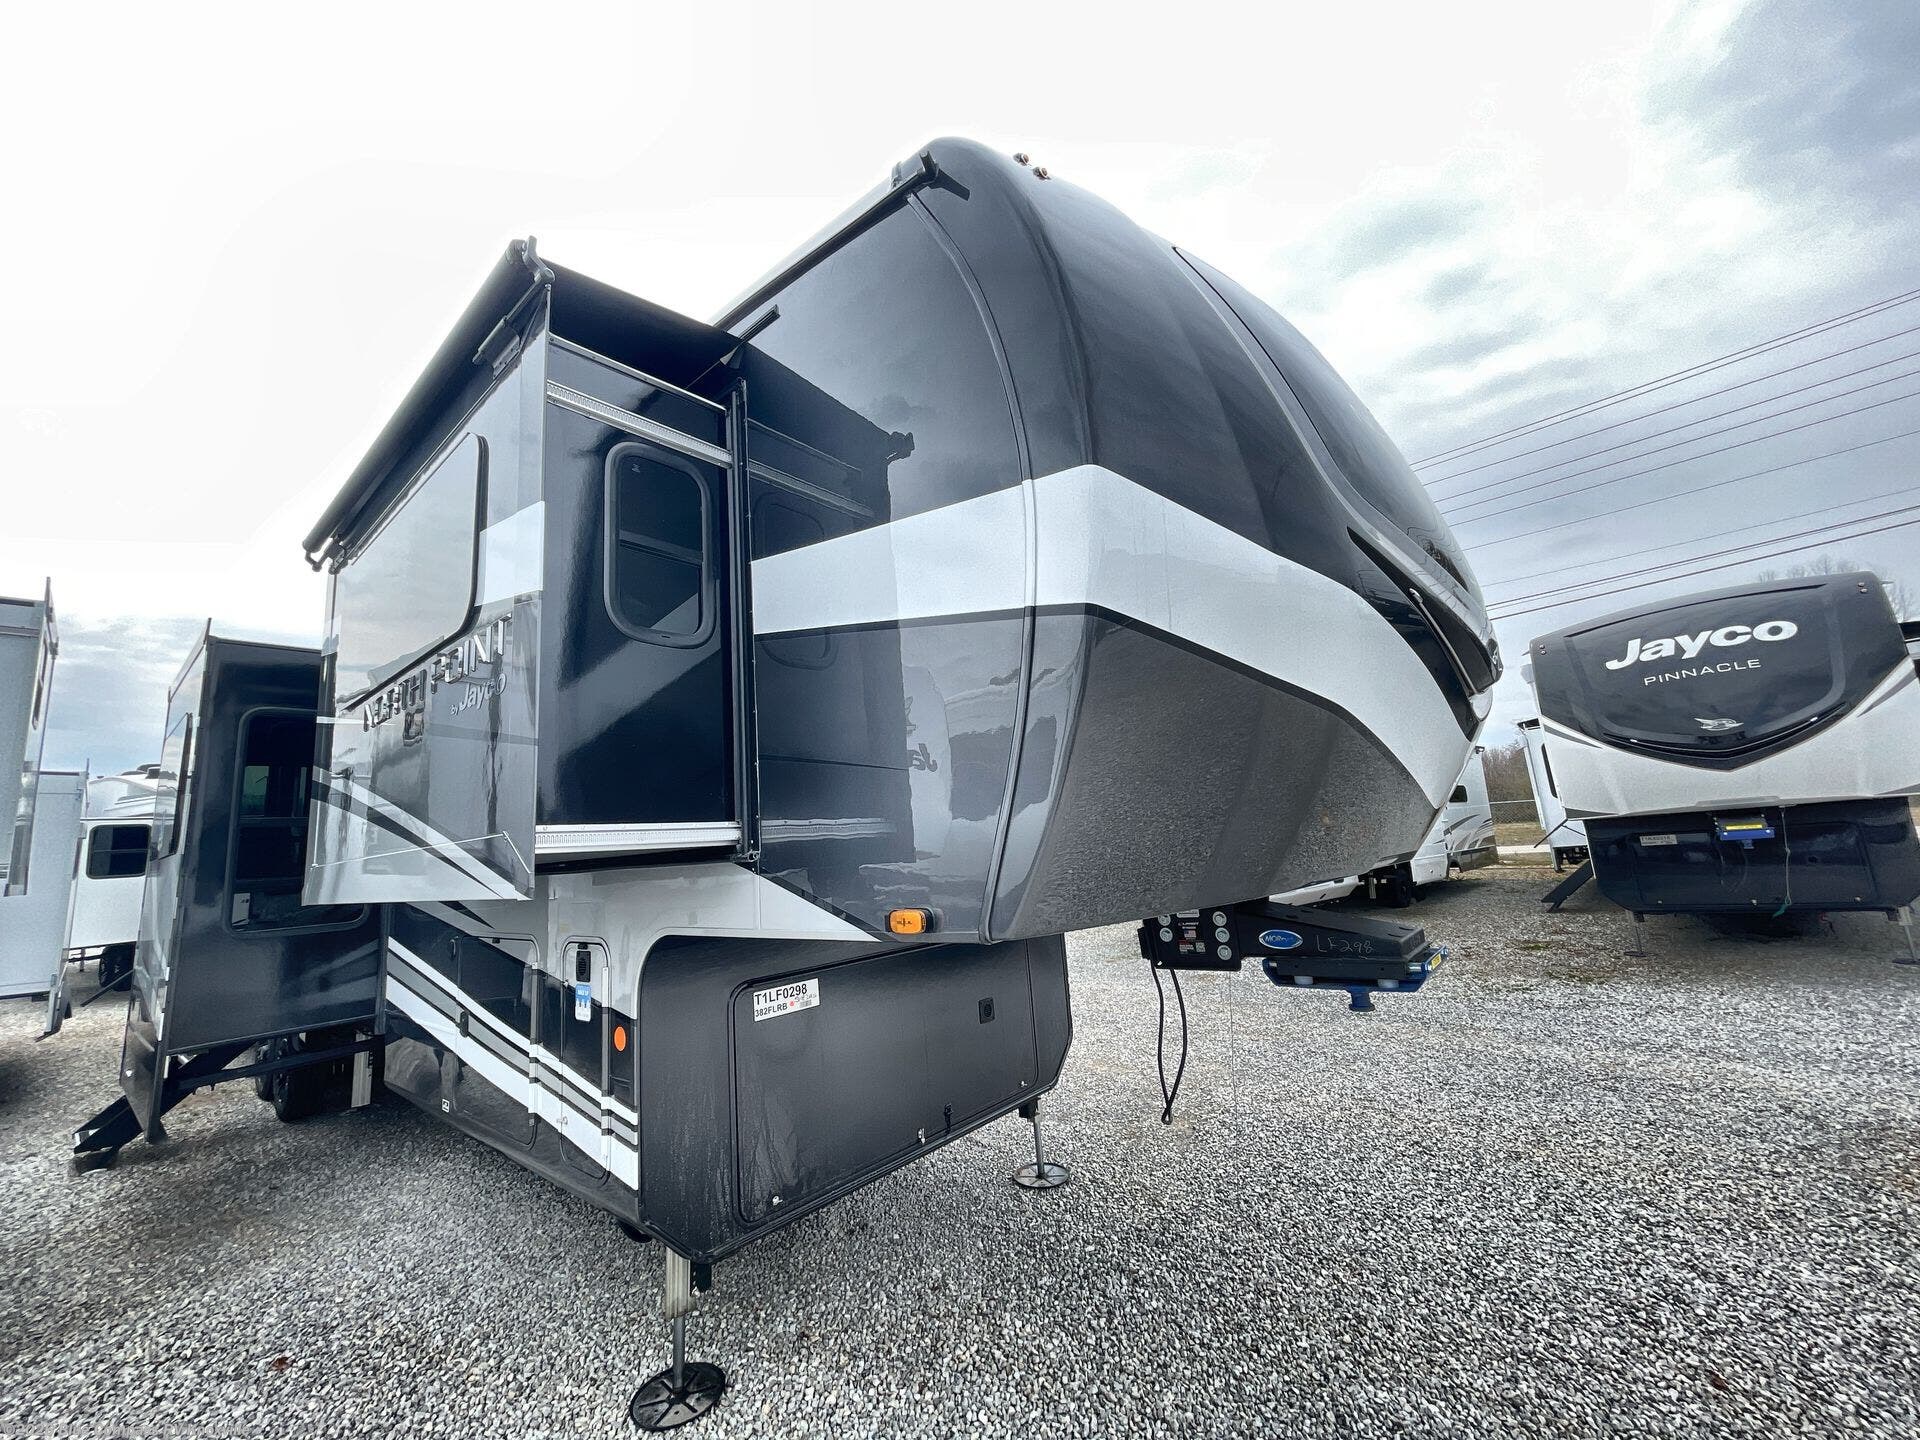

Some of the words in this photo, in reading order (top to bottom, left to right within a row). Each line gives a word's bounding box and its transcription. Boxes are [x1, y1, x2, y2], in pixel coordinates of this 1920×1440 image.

[430, 611, 513, 695] POINT
[1605, 620, 1798, 670] Jayco
[1643, 659, 1762, 686] PINNACLE
[459, 672, 507, 711] Jayco
[755, 984, 807, 1005] T1LF0298
[755, 1003, 787, 1017] 382FLRB
